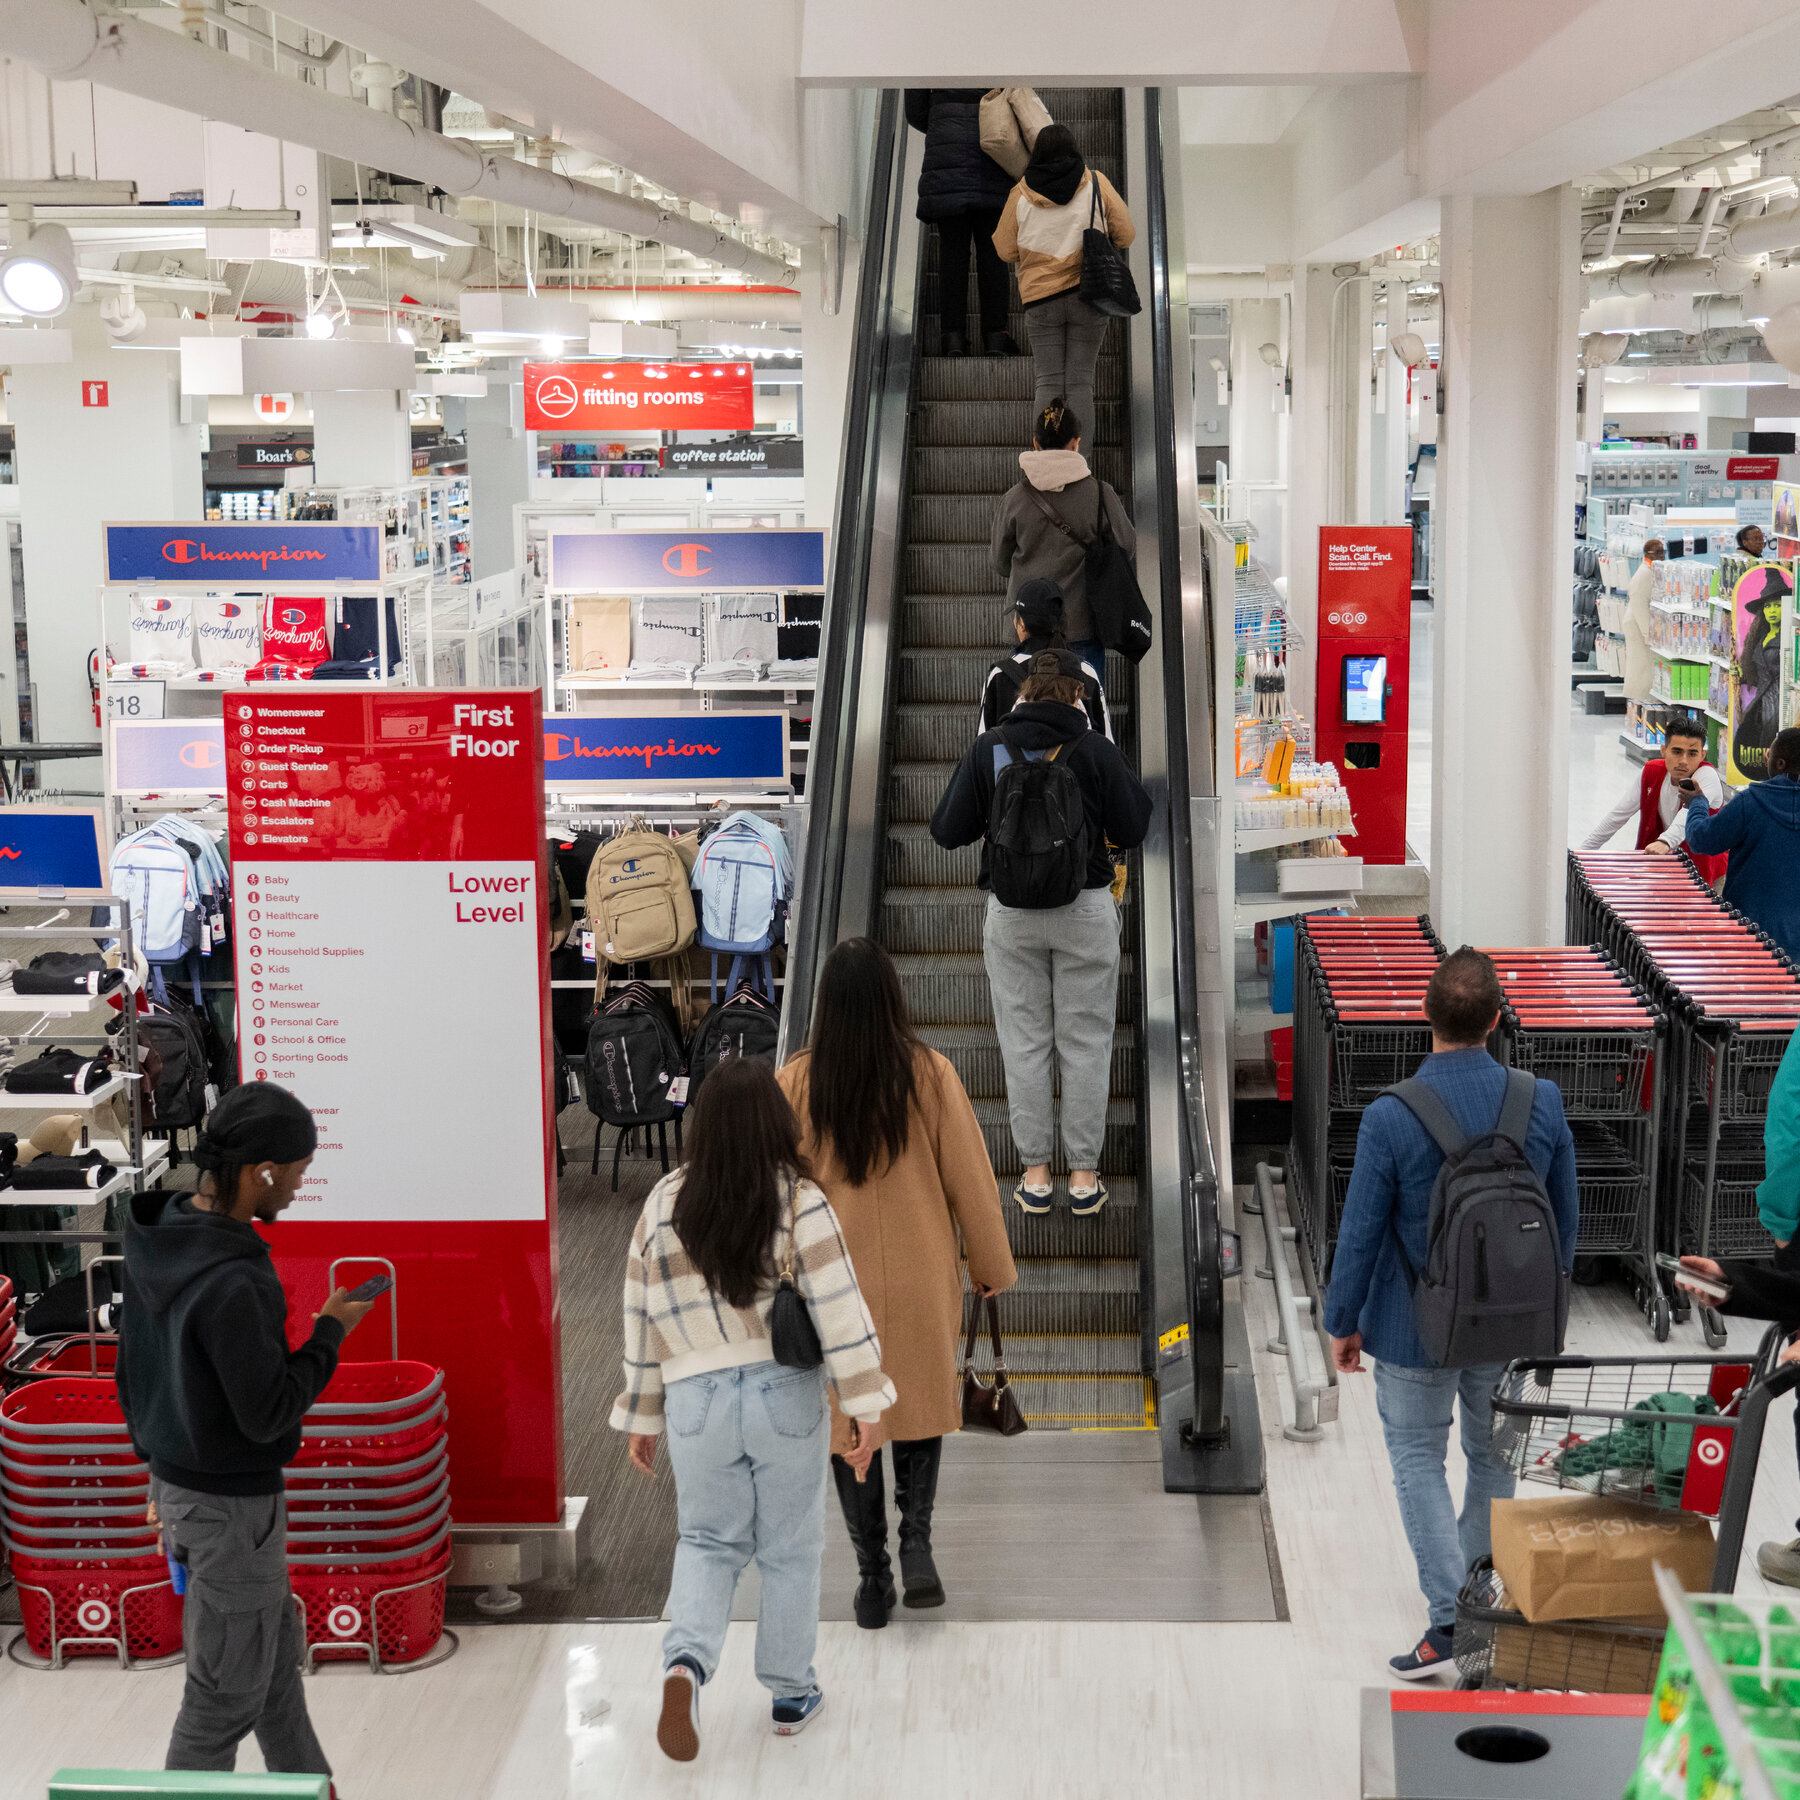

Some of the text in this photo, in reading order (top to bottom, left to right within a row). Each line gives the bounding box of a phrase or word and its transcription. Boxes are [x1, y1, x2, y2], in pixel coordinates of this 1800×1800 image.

[583, 388, 704, 408] fitting rooms
[256, 448, 293, 463] Boar's
[672, 449, 765, 462] coffee station
[1328, 544, 1378, 554] Help Center
[162, 539, 327, 571] Champion
[1328, 553, 1393, 561] Scan. Call. Find.
[720, 610, 777, 623] Champio
[643, 620, 702, 638] Champio
[263, 625, 326, 651] Champion
[107, 695, 141, 716] $18
[257, 707, 325, 718] Womenswear
[453, 703, 514, 727] First
[257, 726, 306, 736] Checkout
[258, 744, 324, 755] Order Pickup
[450, 734, 520, 757] Floor
[543, 733, 721, 769] Champion
[1740, 744, 1770, 766] WICK
[259, 762, 328, 771] Guest Service
[260, 780, 288, 789] Carts
[260, 798, 331, 808] Cash Machine
[261, 816, 314, 826] Escalators
[262, 834, 309, 844] Elevators
[264, 875, 289, 886] Baby
[609, 869, 655, 885] Champion
[448, 872, 531, 893] Lower
[265, 893, 300, 904] Beauty
[266, 911, 319, 920] Healthcare
[456, 901, 524, 923] Level
[267, 929, 296, 938] Home
[267, 947, 365, 957] Household Supplies
[268, 964, 291, 974] Kids
[269, 982, 303, 991] Market
[269, 1000, 320, 1009] Menswear
[270, 1017, 339, 1026] Personal Care
[271, 1035, 346, 1044] School & Office
[272, 1053, 349, 1063] Sporting Goods
[272, 1070, 295, 1079] Tech
[310, 1107, 340, 1115] swear
[316, 1142, 344, 1150] ooms
[303, 1176, 328, 1185] ators
[293, 1194, 323, 1202] vators
